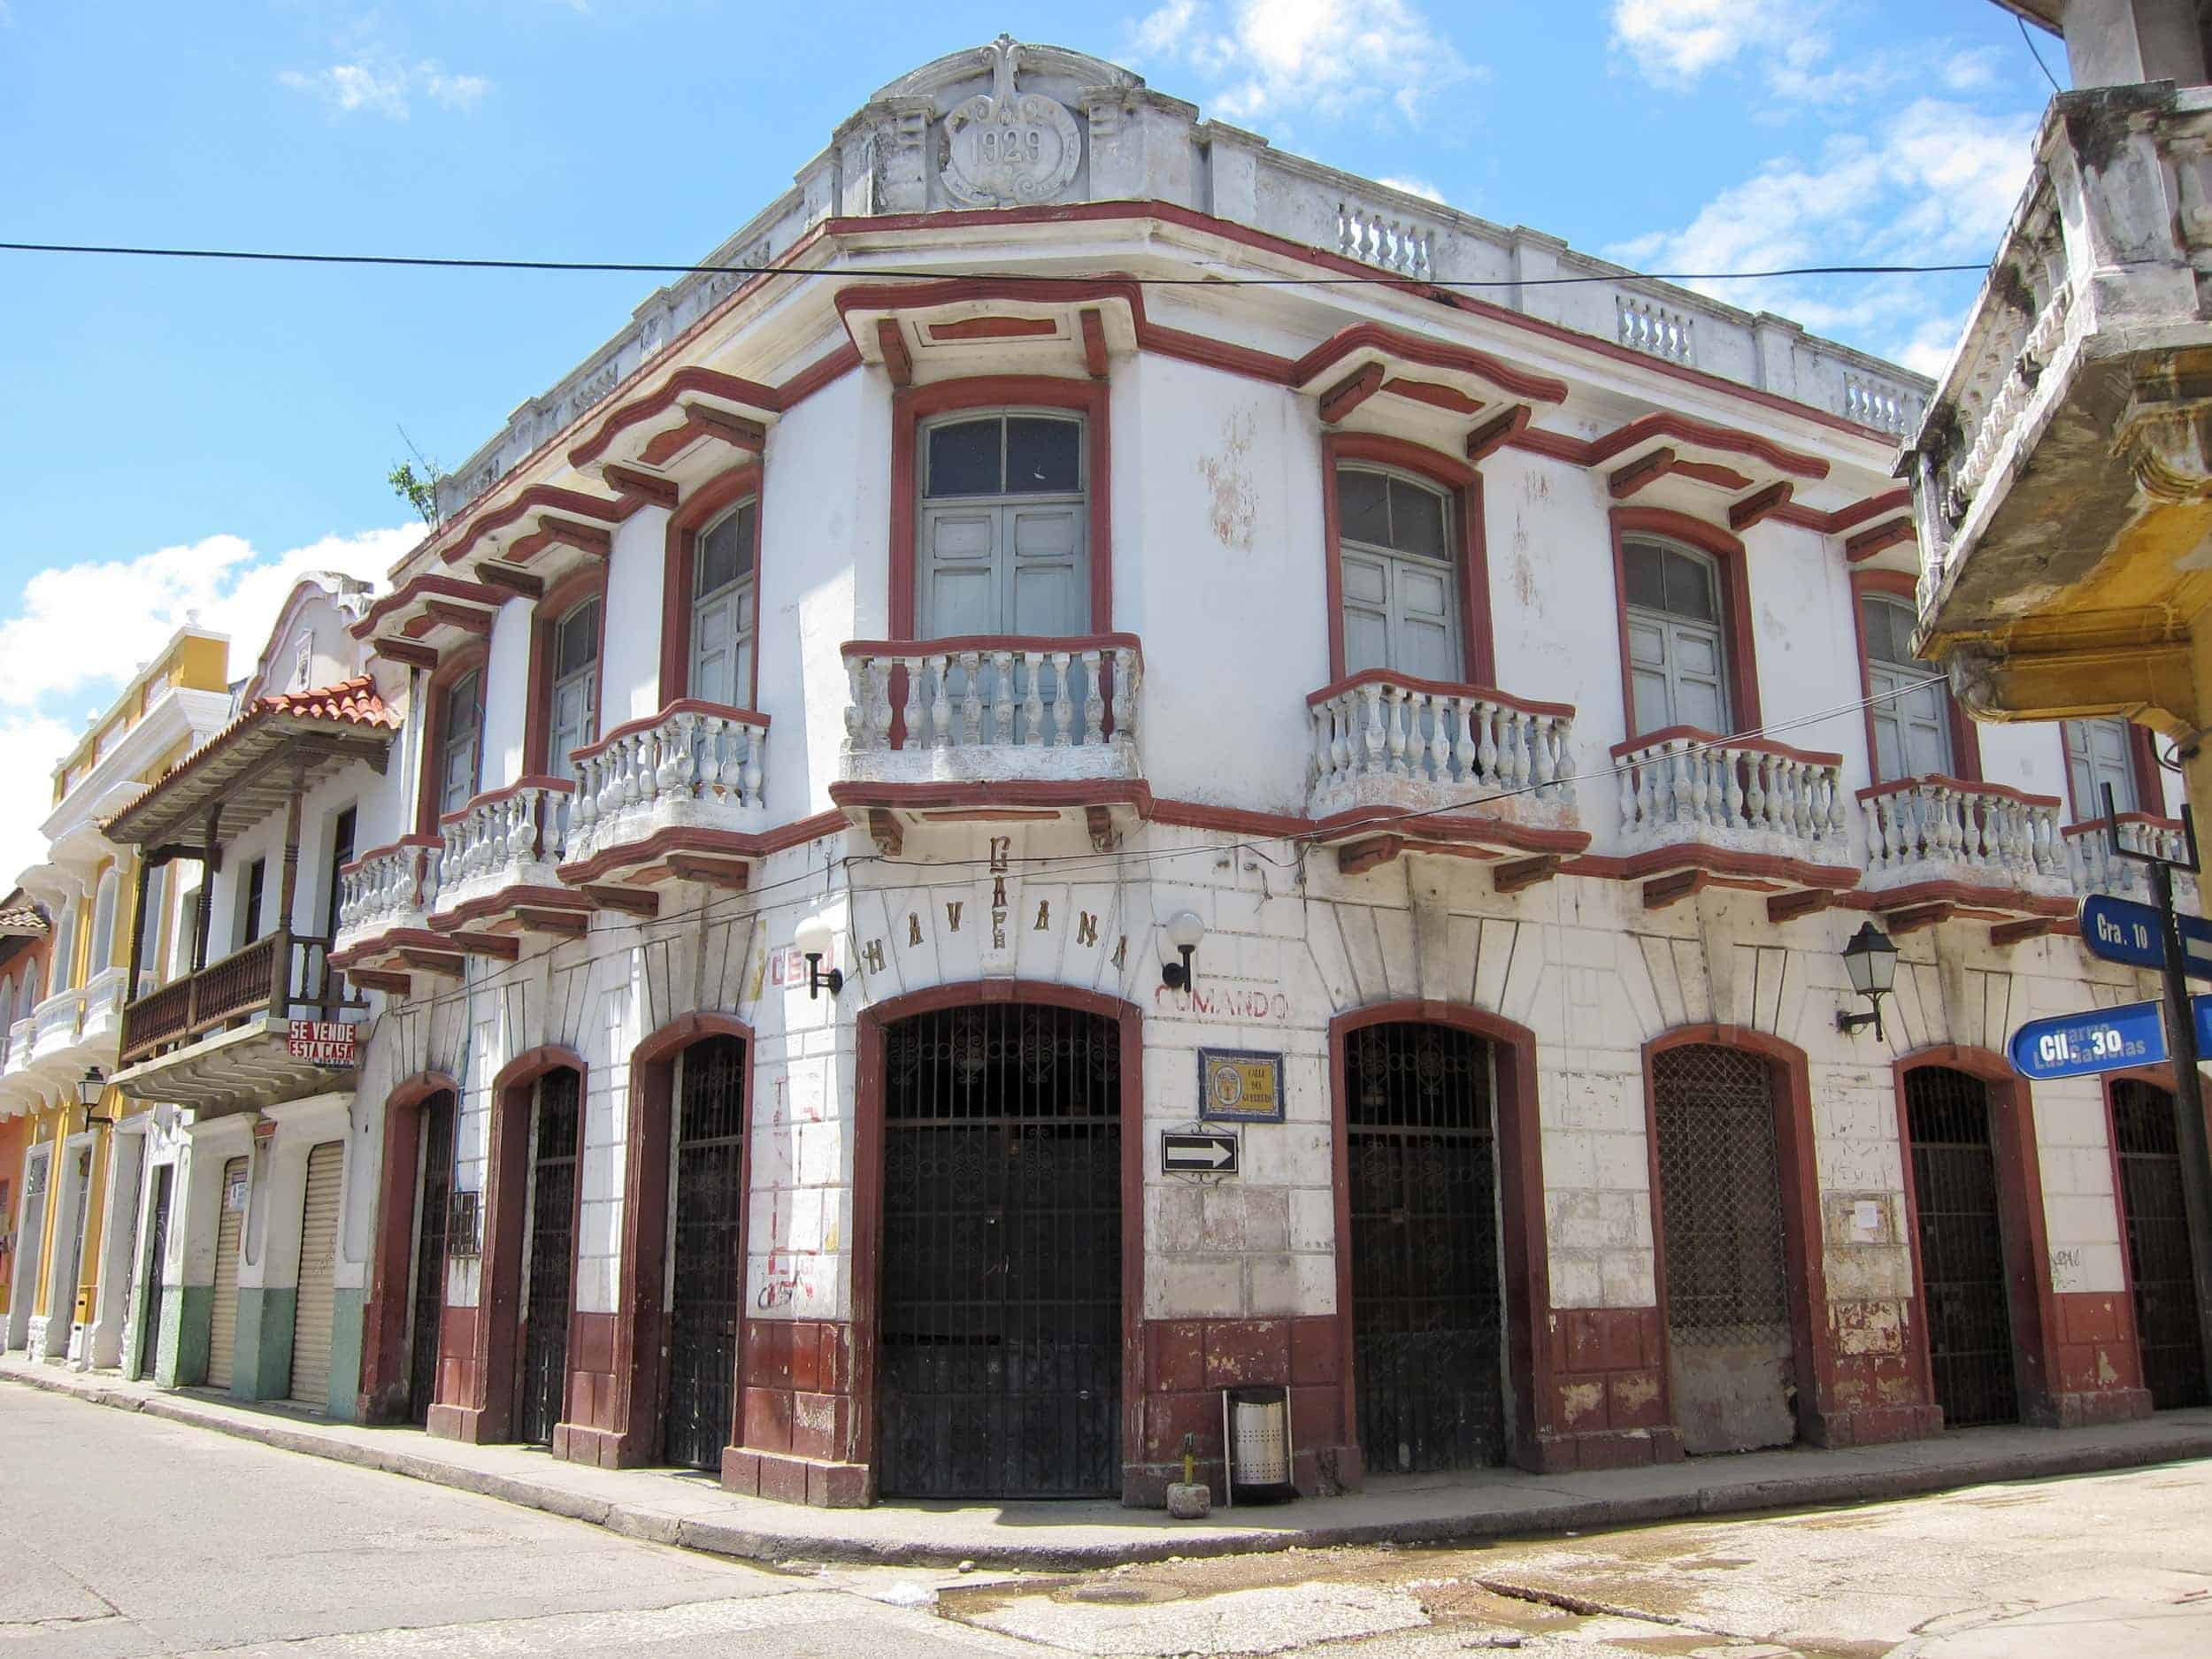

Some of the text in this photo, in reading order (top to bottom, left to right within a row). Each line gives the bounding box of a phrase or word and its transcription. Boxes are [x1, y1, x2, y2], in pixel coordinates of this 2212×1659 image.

[970, 129, 1041, 165] 1929
[863, 900, 1127, 976] HAVANA
[2096, 912, 2148, 949] Cra. 10
[290, 1020, 355, 1042] SE VENDE
[2039, 1030, 2122, 1062] Cll. 30
[289, 1041, 354, 1059] ESTA CASA
